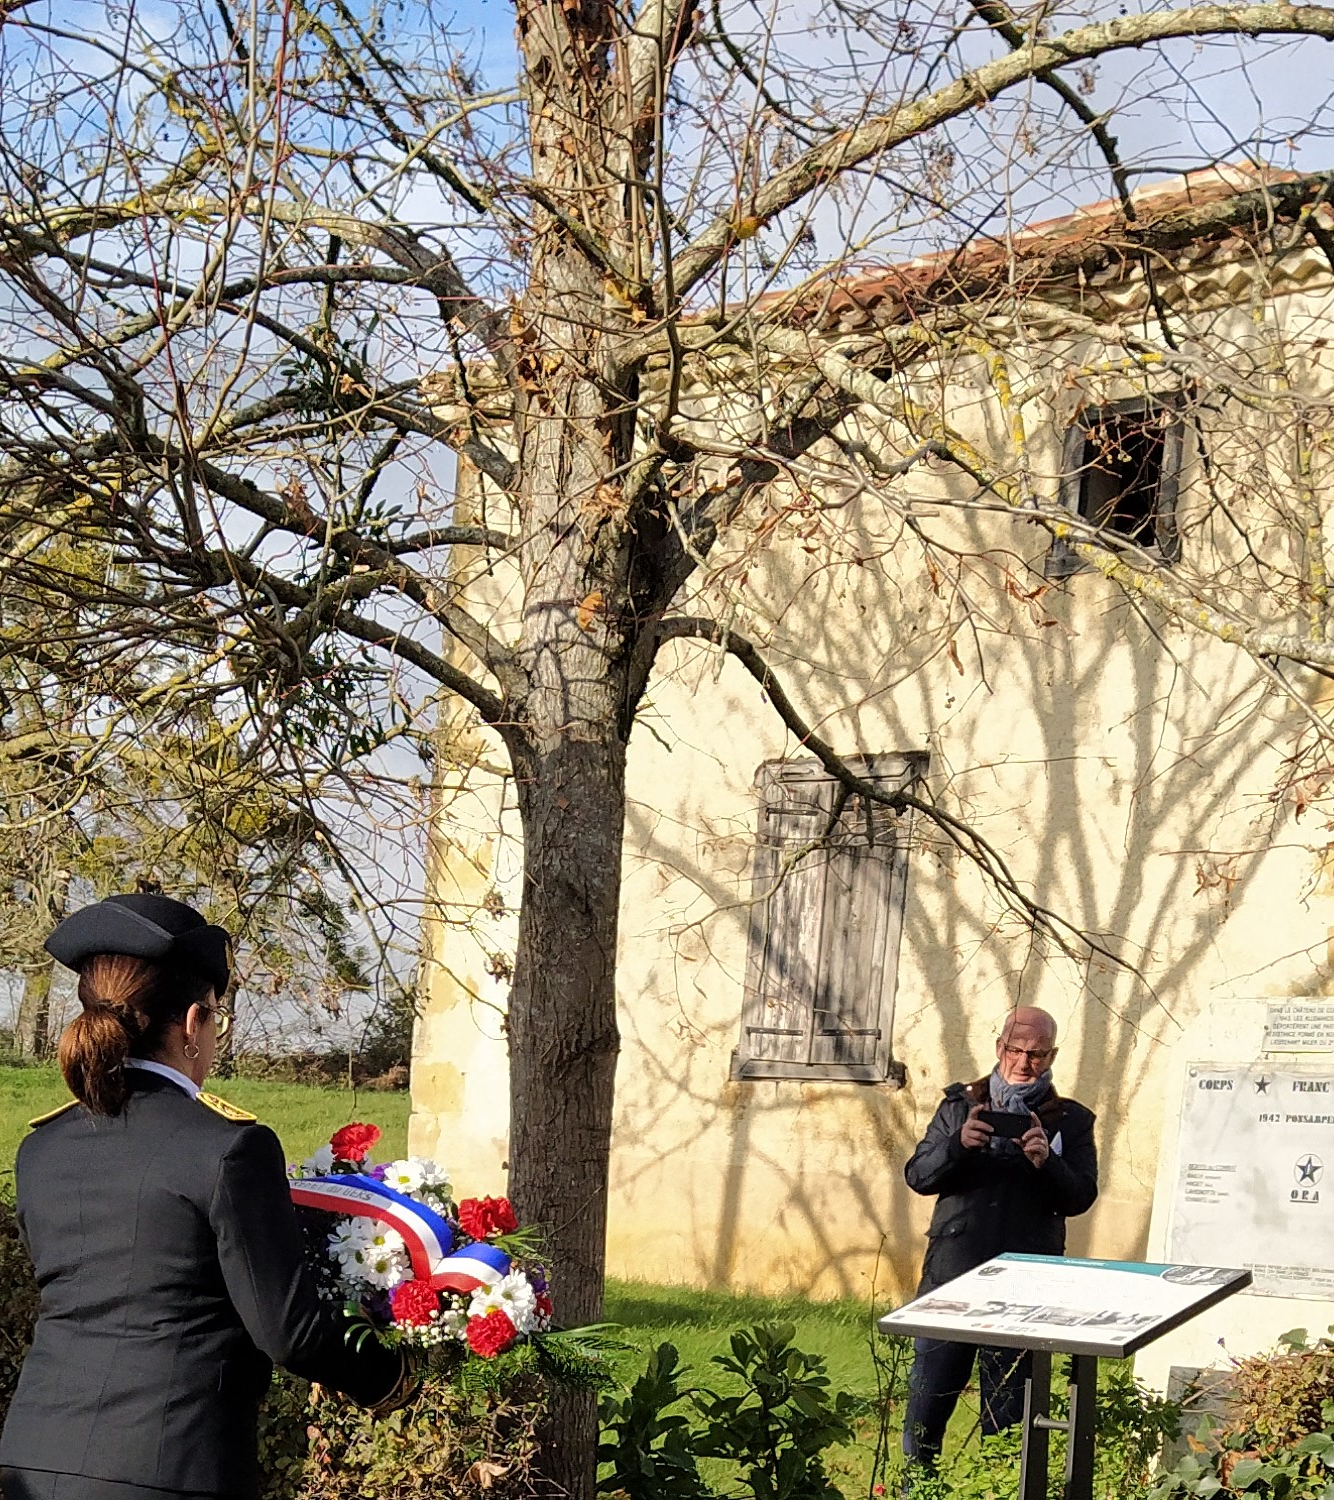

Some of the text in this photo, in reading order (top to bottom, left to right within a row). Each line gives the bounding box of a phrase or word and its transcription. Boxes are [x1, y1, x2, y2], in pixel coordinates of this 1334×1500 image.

[1198, 1080, 1234, 1092] CORPS
[1292, 1081, 1330, 1093] FRANC
[1259, 1113, 1280, 1123] 1942
